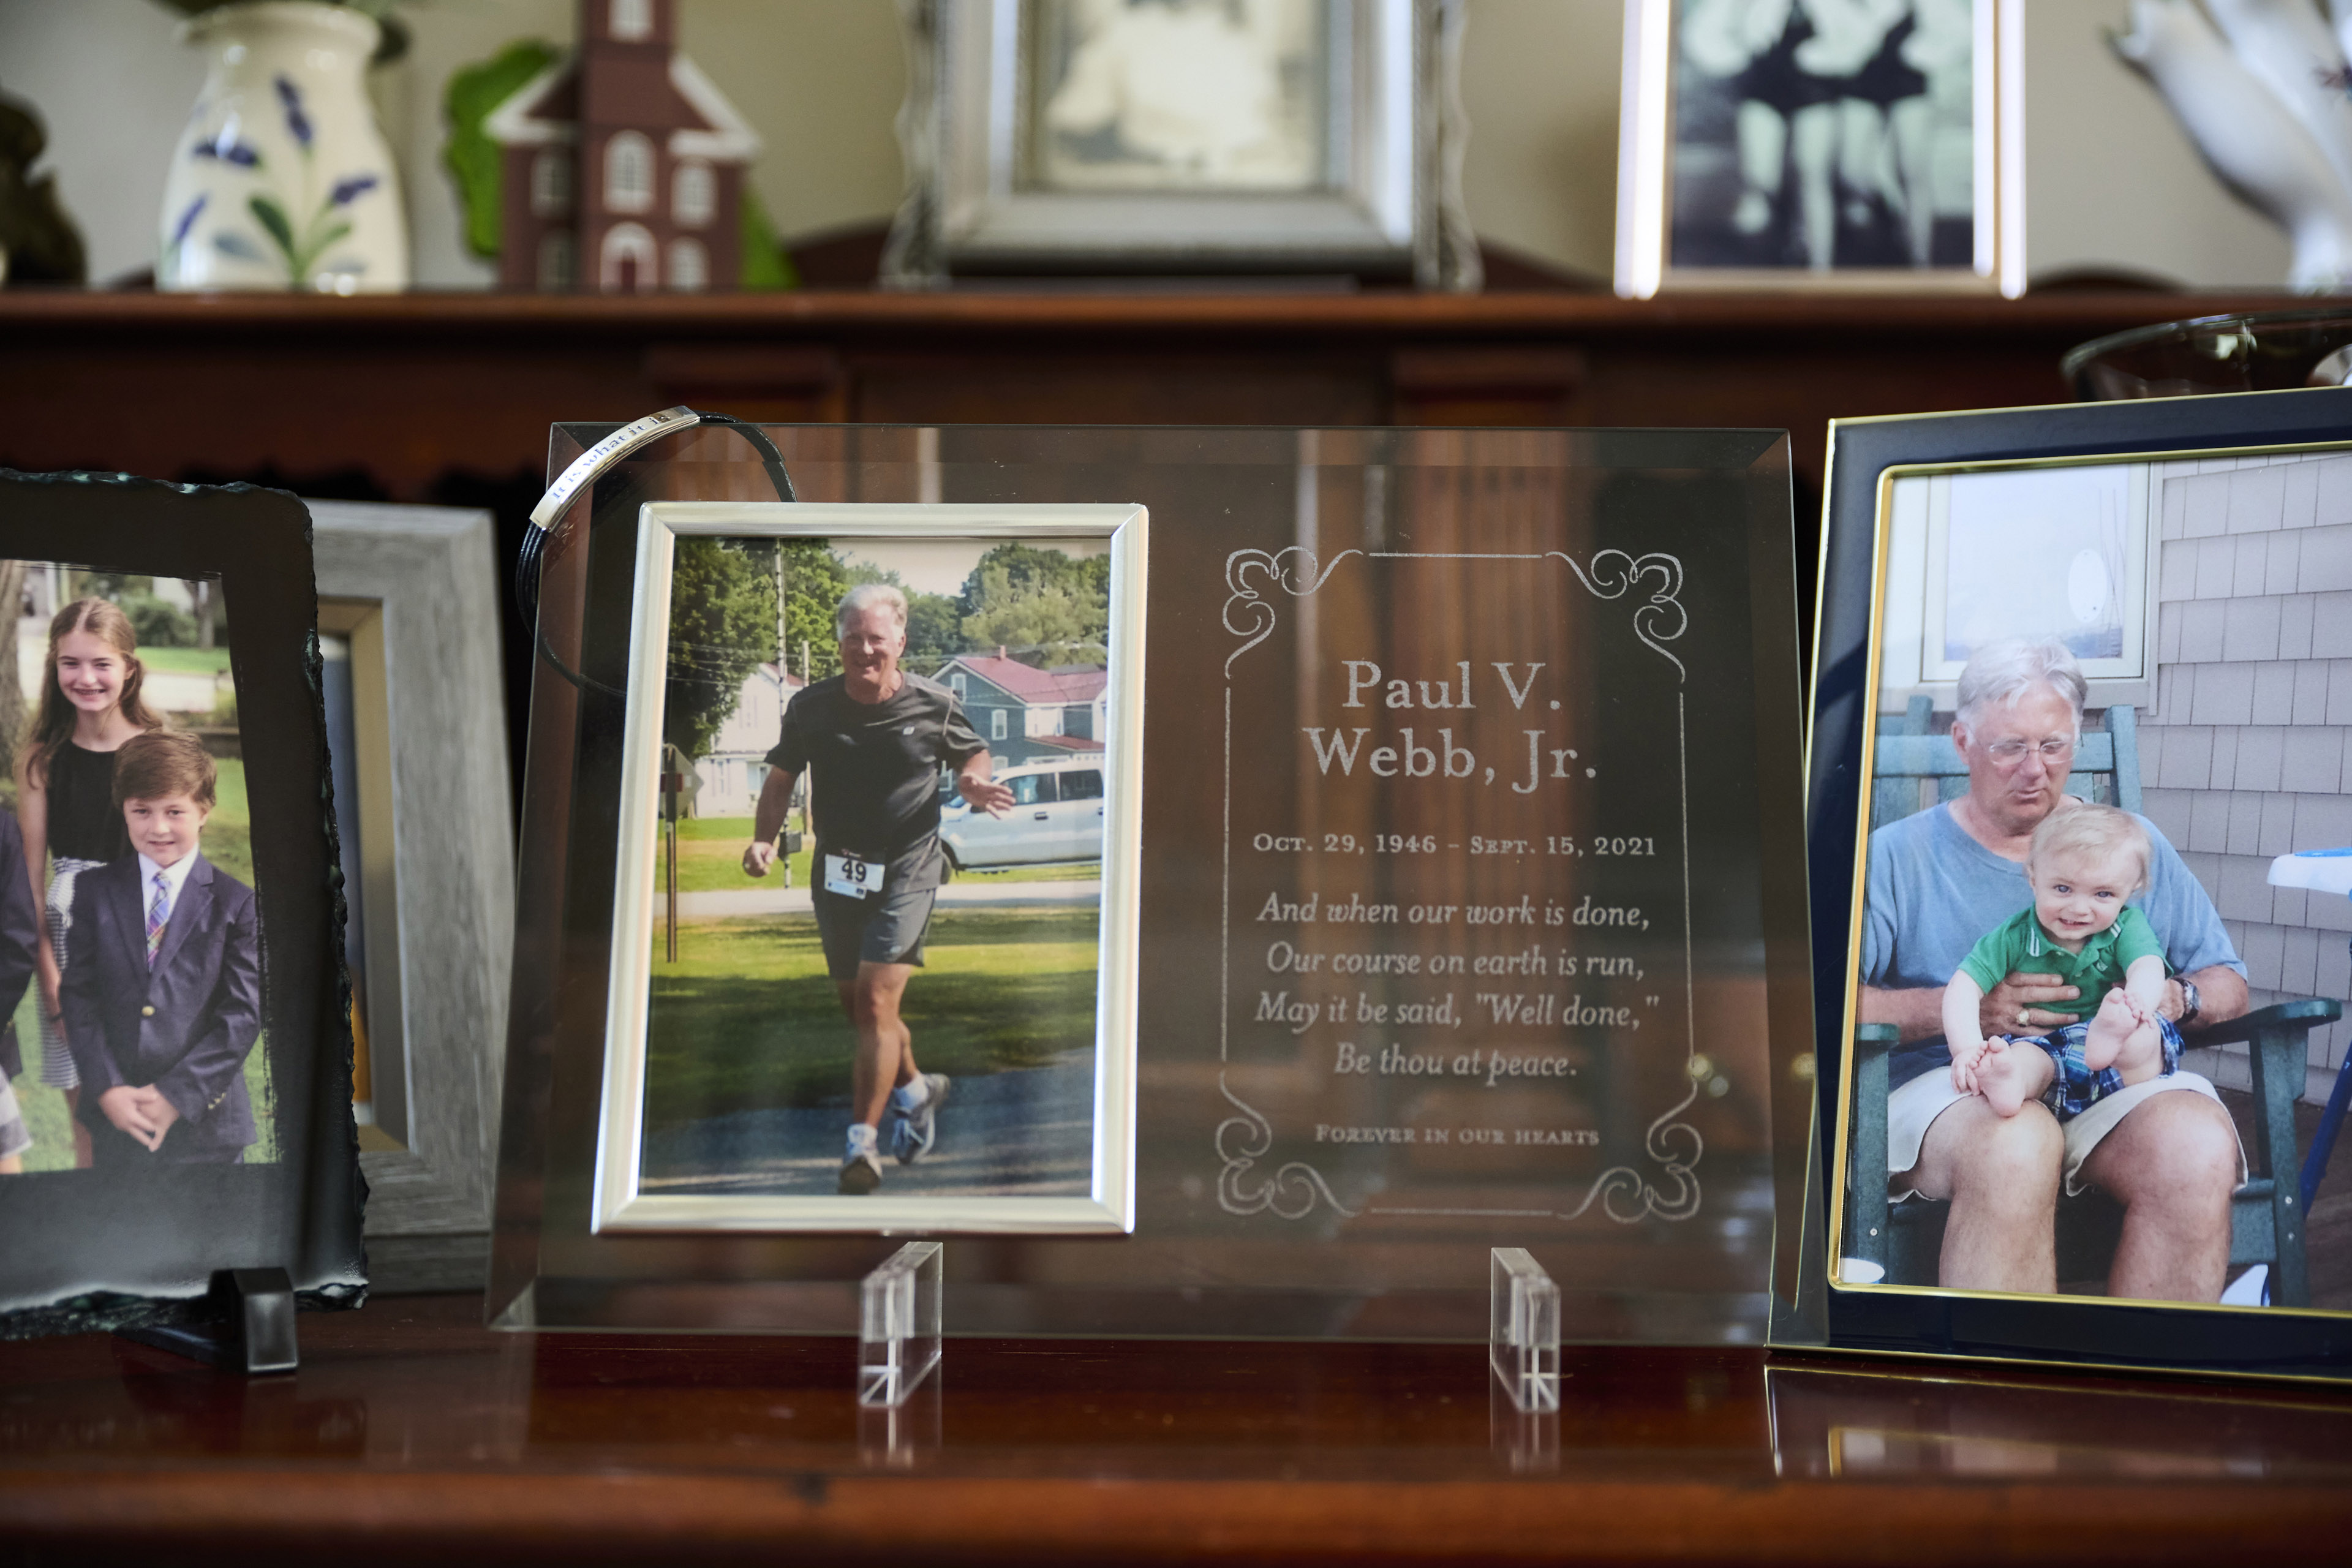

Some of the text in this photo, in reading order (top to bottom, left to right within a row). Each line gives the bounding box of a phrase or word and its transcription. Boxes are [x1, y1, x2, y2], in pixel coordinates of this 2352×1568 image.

[582, 435, 627, 466] what
[628, 424, 647, 436] it
[649, 415, 671, 424] is
[1341, 659, 1562, 711] Paul V.
[1301, 727, 1597, 794] Webb, Jr.
[1324, 833, 1365, 856] 29,
[1376, 834, 1437, 854] 1946
[1547, 836, 1585, 858] 15,
[1594, 837, 1656, 856] 2021
[842, 859, 867, 883] 49
[1256, 891, 1650, 931] And when our work is done,
[1266, 941, 1645, 982] Our course on earth is run,
[1254, 990, 1660, 1034] May it be said, "Well done,"
[1334, 1041, 1578, 1087] Be thou at peace.
